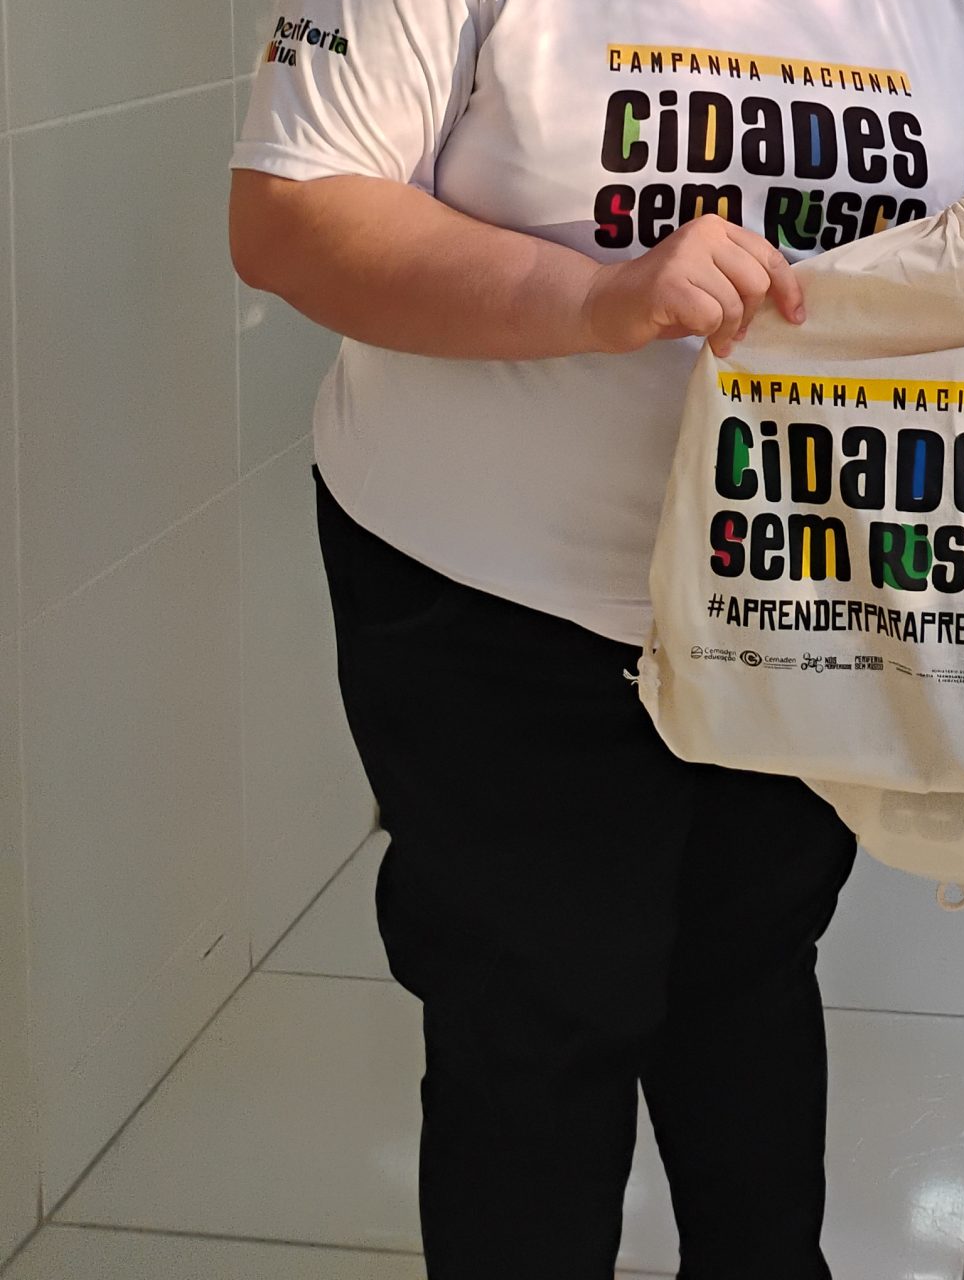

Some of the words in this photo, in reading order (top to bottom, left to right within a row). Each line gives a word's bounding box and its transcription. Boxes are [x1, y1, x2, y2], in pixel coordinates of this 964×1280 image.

[609, 48, 761, 82] CAMPANHA
[781, 62, 913, 98] NACIONAL
[721, 377, 868, 410] AMPANHA
[764, 655, 797, 663] Cemaden
